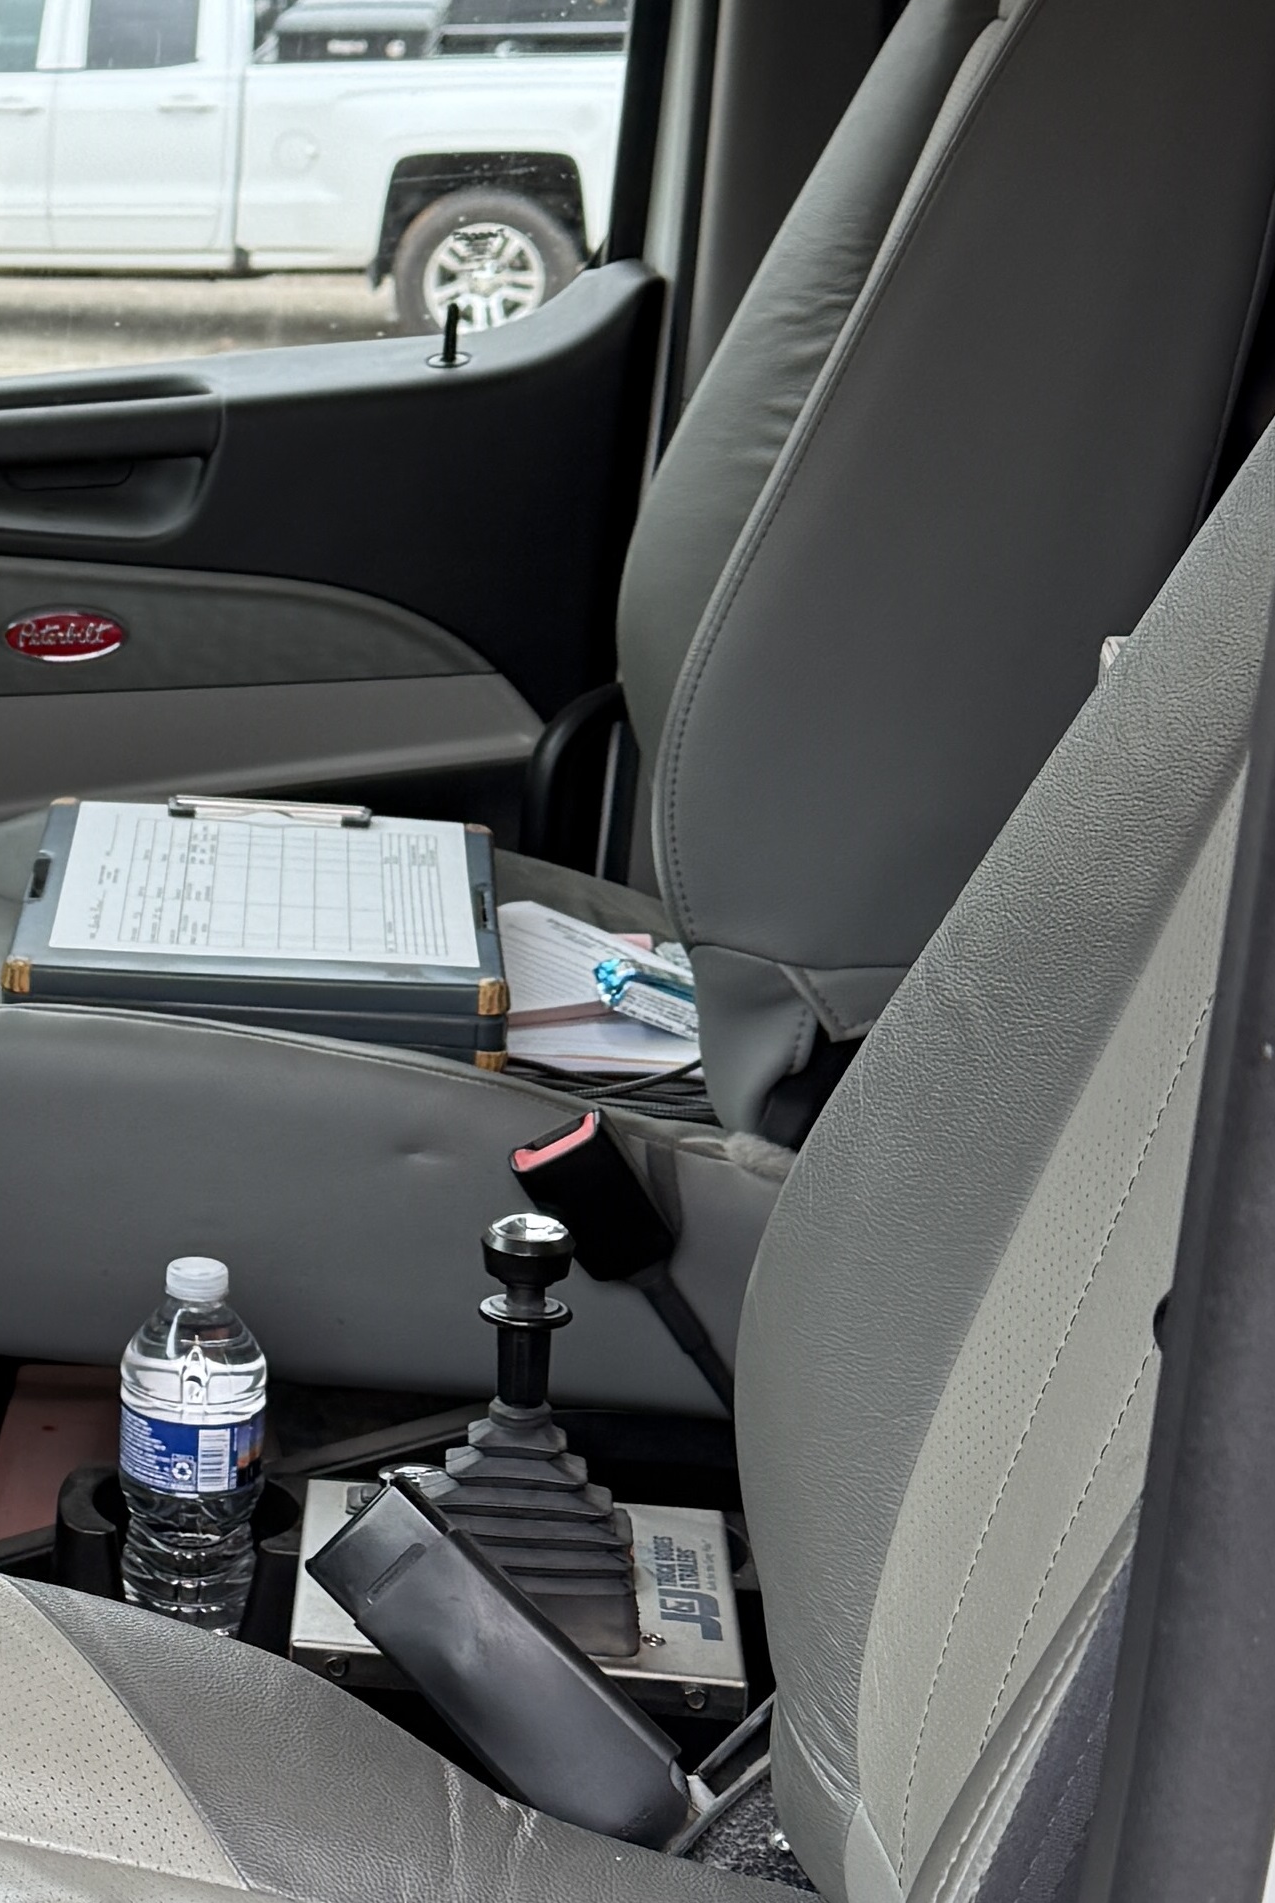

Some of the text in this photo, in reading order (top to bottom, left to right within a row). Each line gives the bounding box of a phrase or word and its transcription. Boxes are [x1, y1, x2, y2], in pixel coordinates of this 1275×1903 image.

[19, 620, 113, 647] Peterbilt
[653, 1536, 677, 1587] TRUCK BODIES
[678, 1547, 699, 1582] TRAILERS
